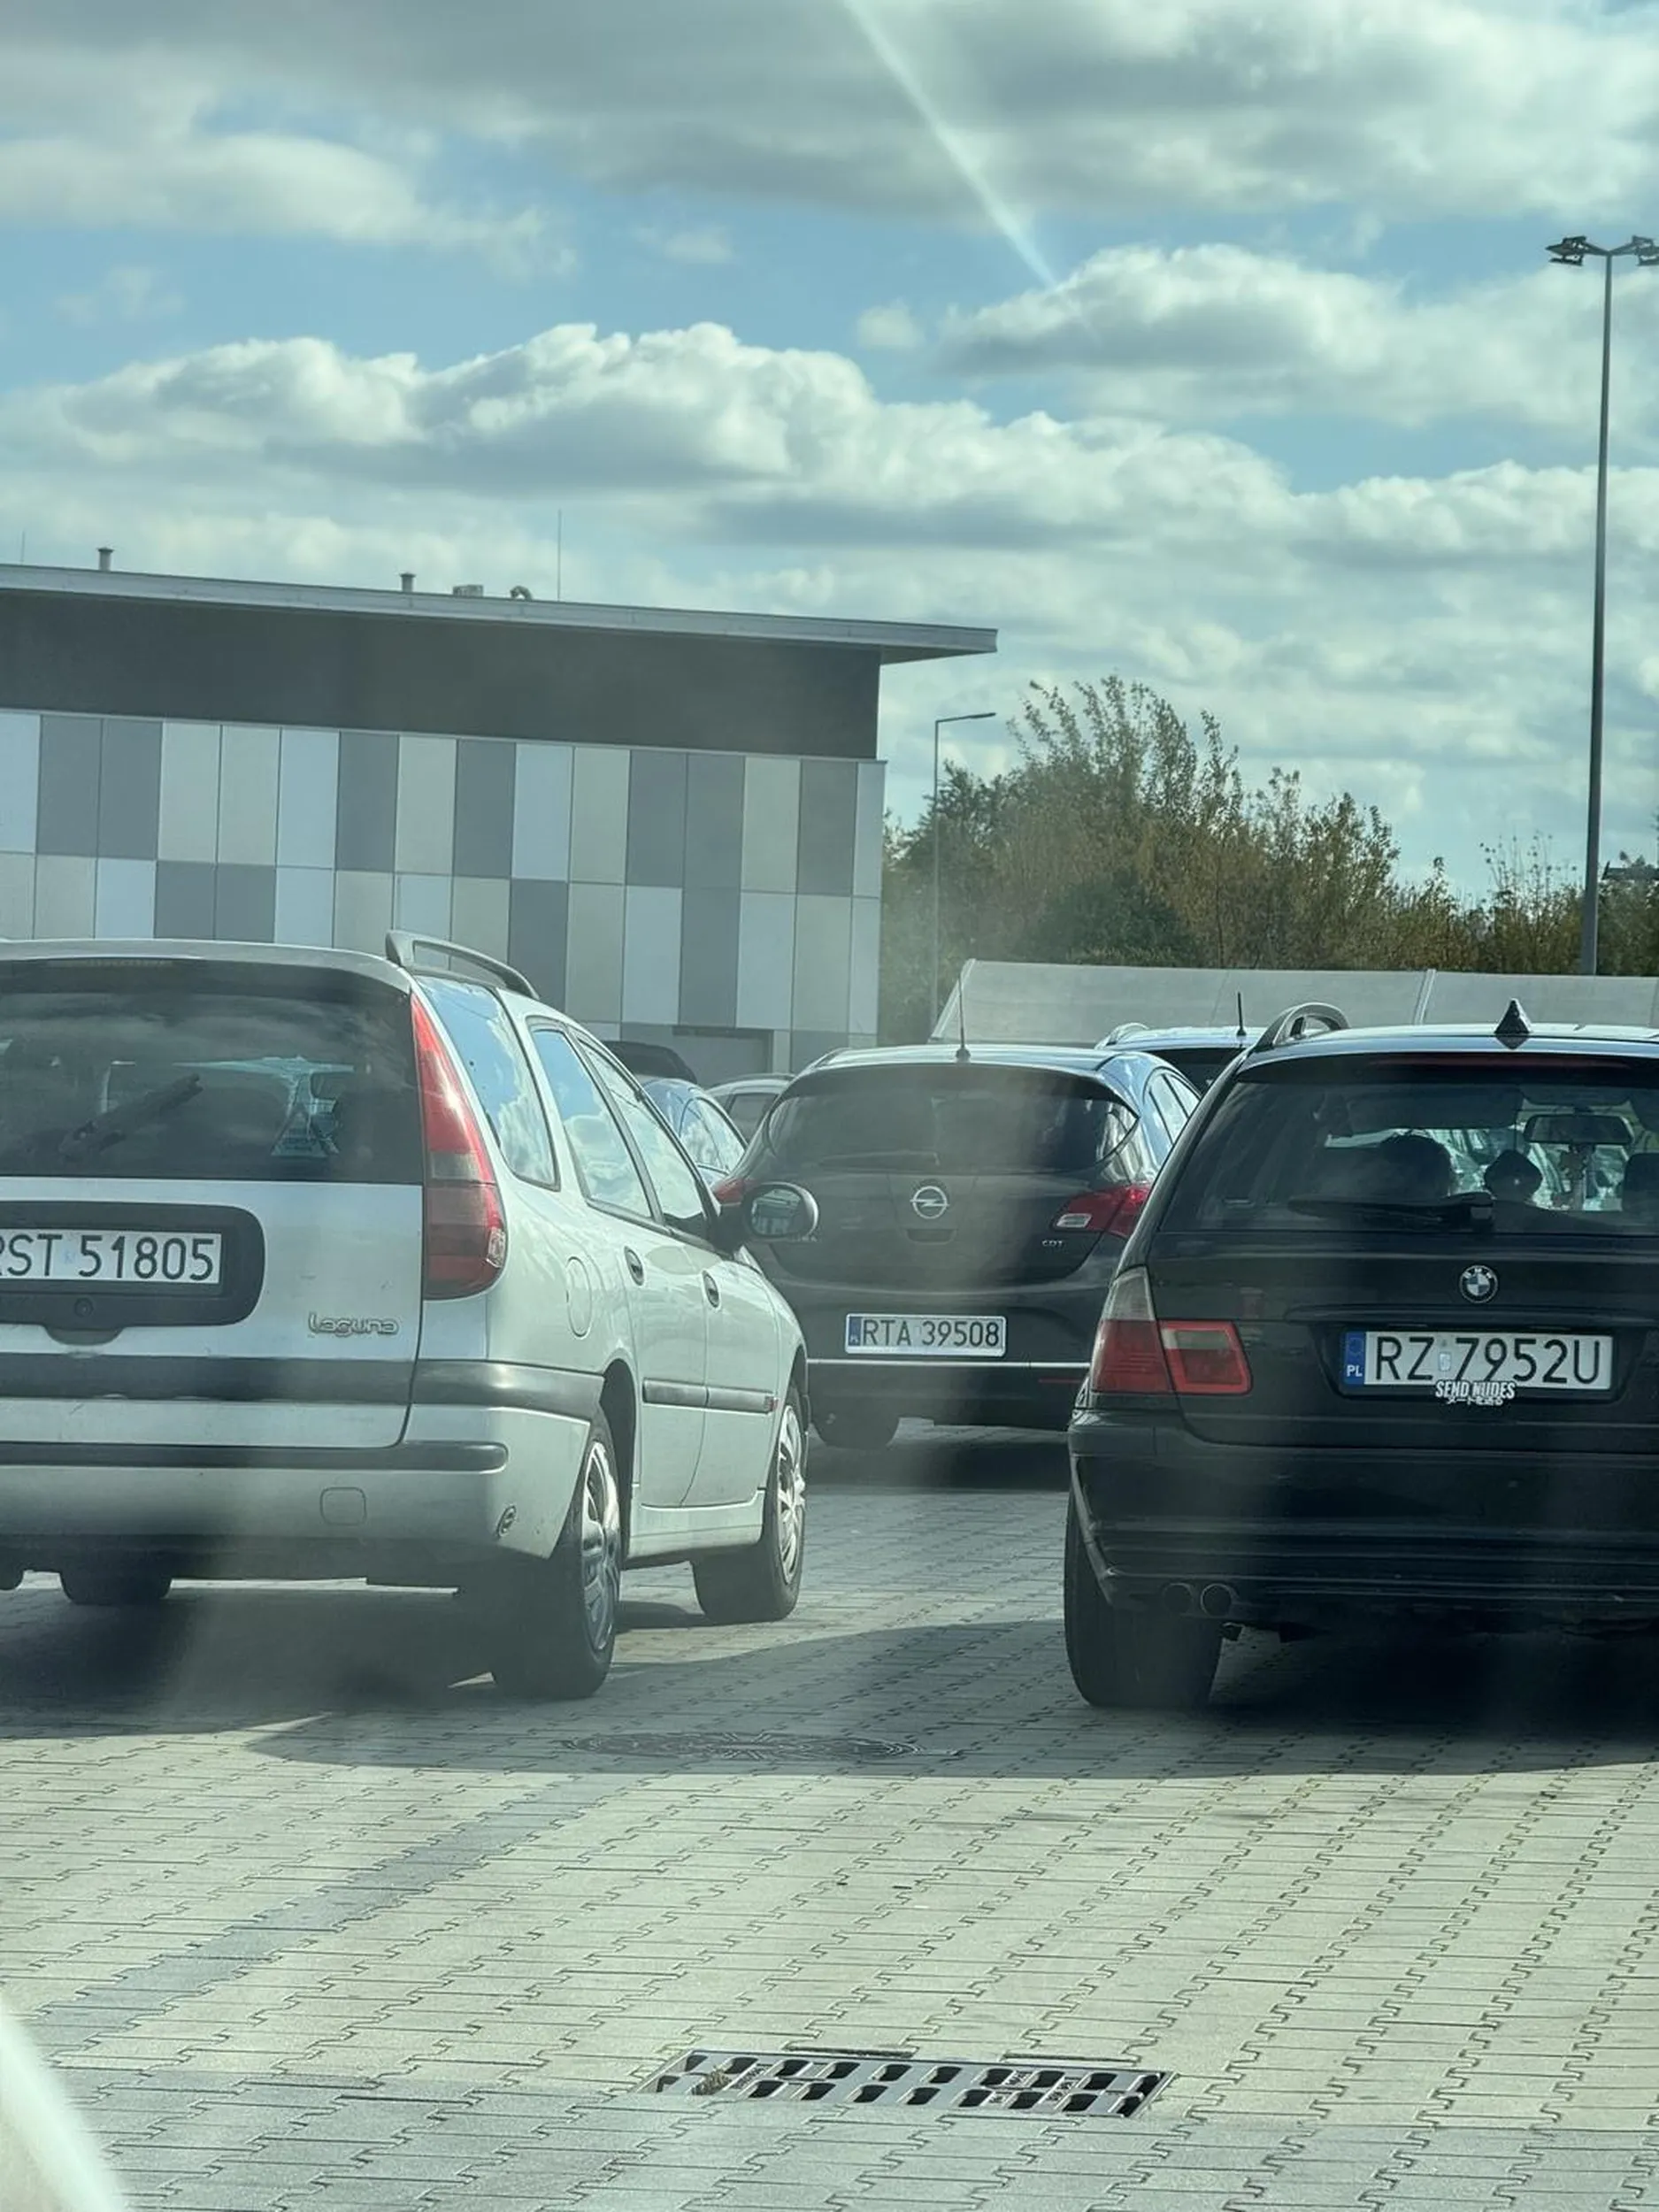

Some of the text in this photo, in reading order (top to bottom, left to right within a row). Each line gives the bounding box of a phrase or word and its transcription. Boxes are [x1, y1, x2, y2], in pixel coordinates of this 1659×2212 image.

[0, 1234, 214, 1281] ST 51805
[863, 1319, 1000, 1347] RTA 39508
[1347, 1365, 1363, 1377] PL
[1375, 1336, 1600, 1385] RZ 7952U
[1435, 1380, 1516, 1399] SEND NUDES
